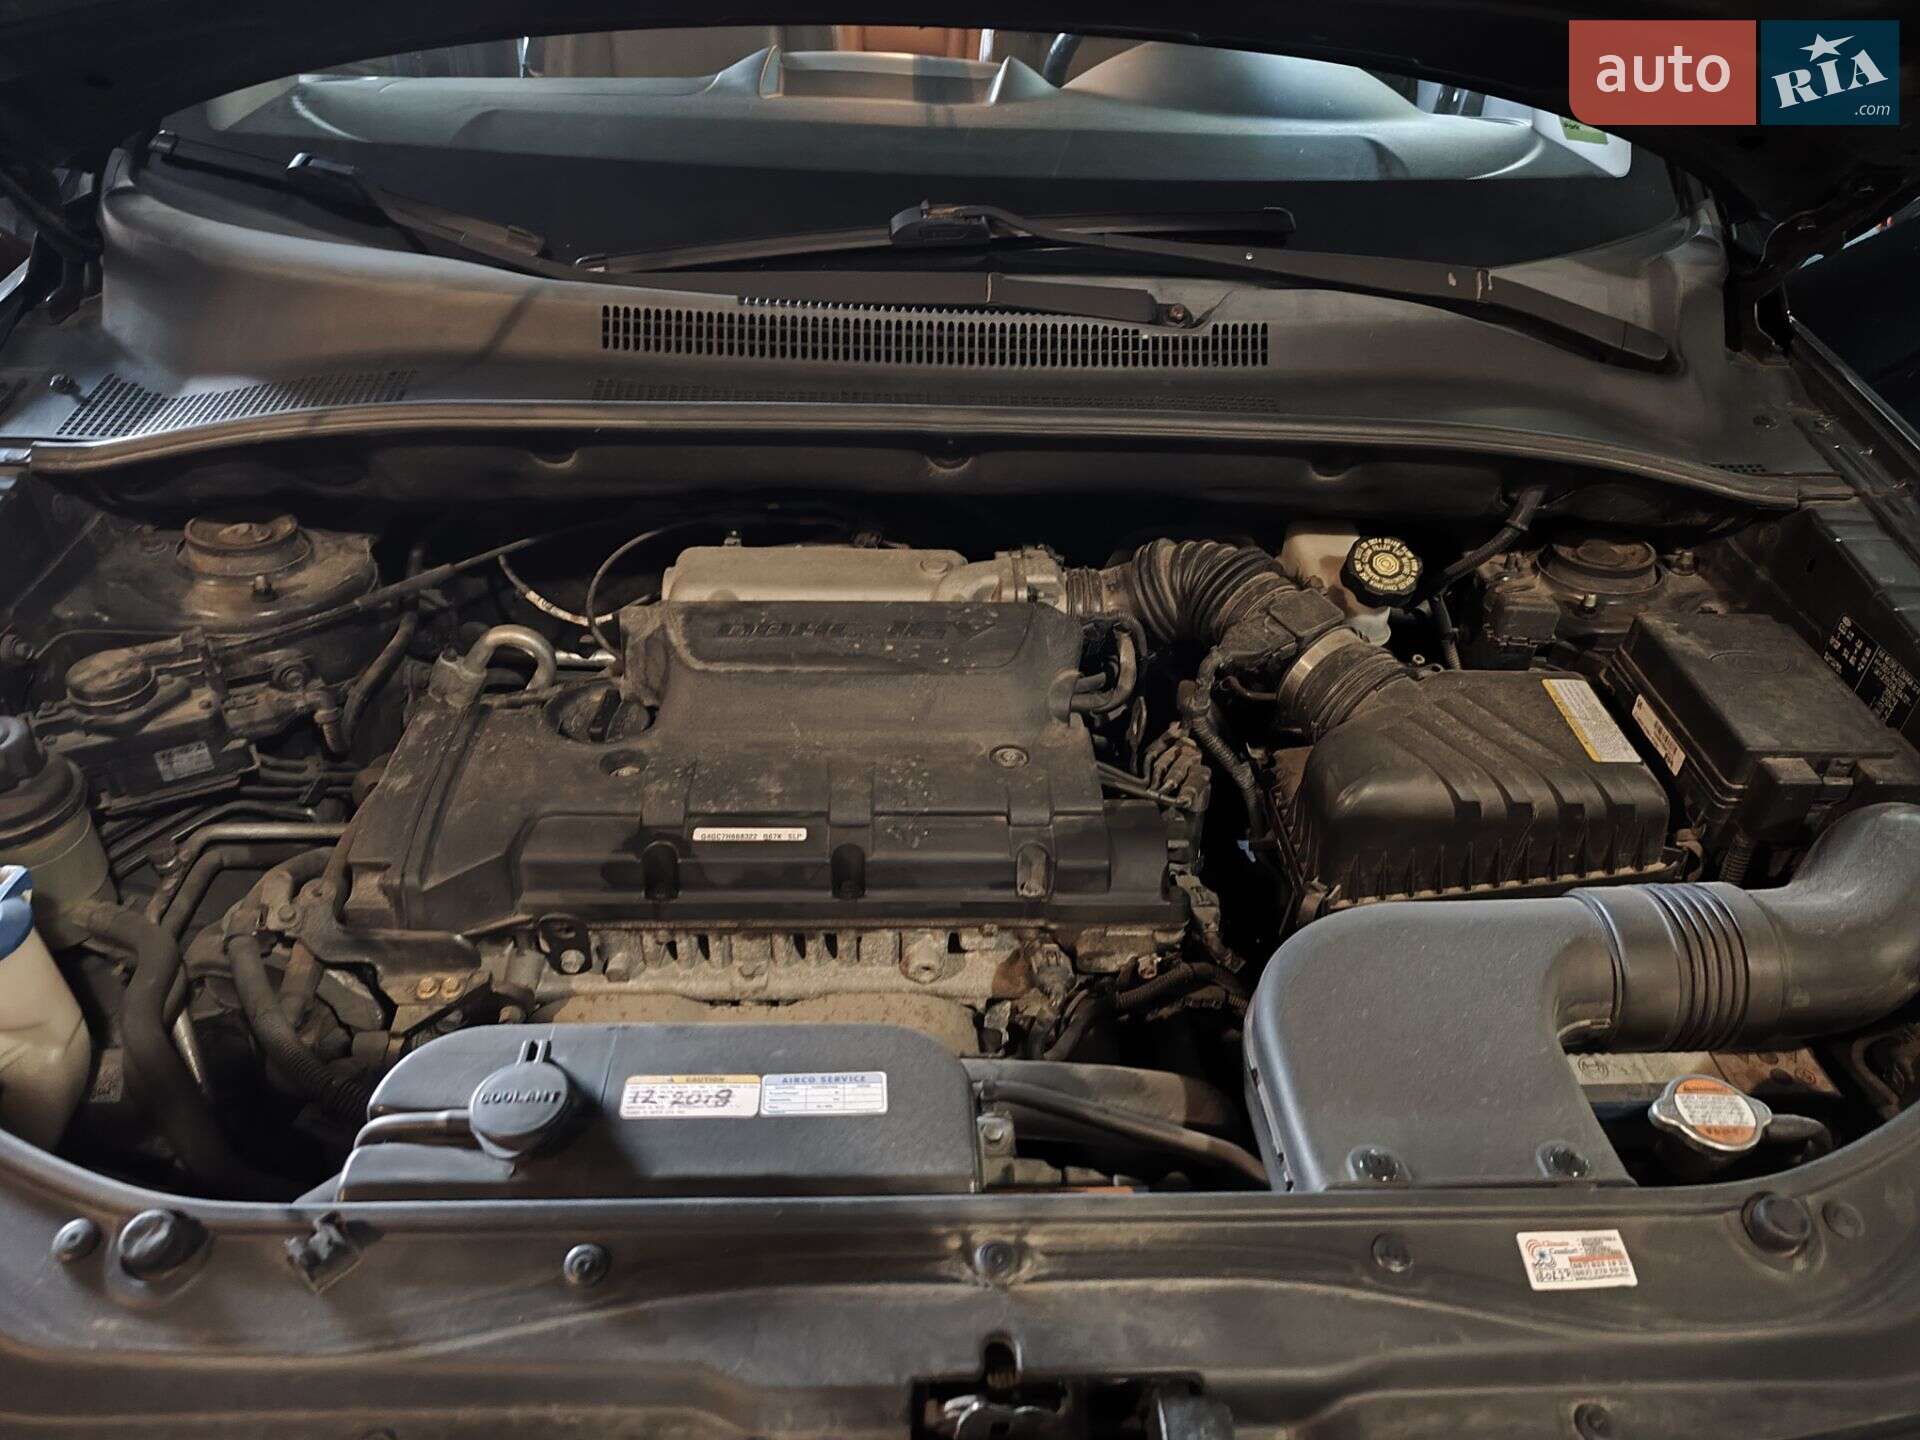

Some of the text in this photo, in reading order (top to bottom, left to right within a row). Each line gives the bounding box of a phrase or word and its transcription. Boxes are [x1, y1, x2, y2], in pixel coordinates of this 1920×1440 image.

[782, 1074, 866, 1084] AIRCO SERVICE
[480, 1088, 562, 1104] COOLANT
